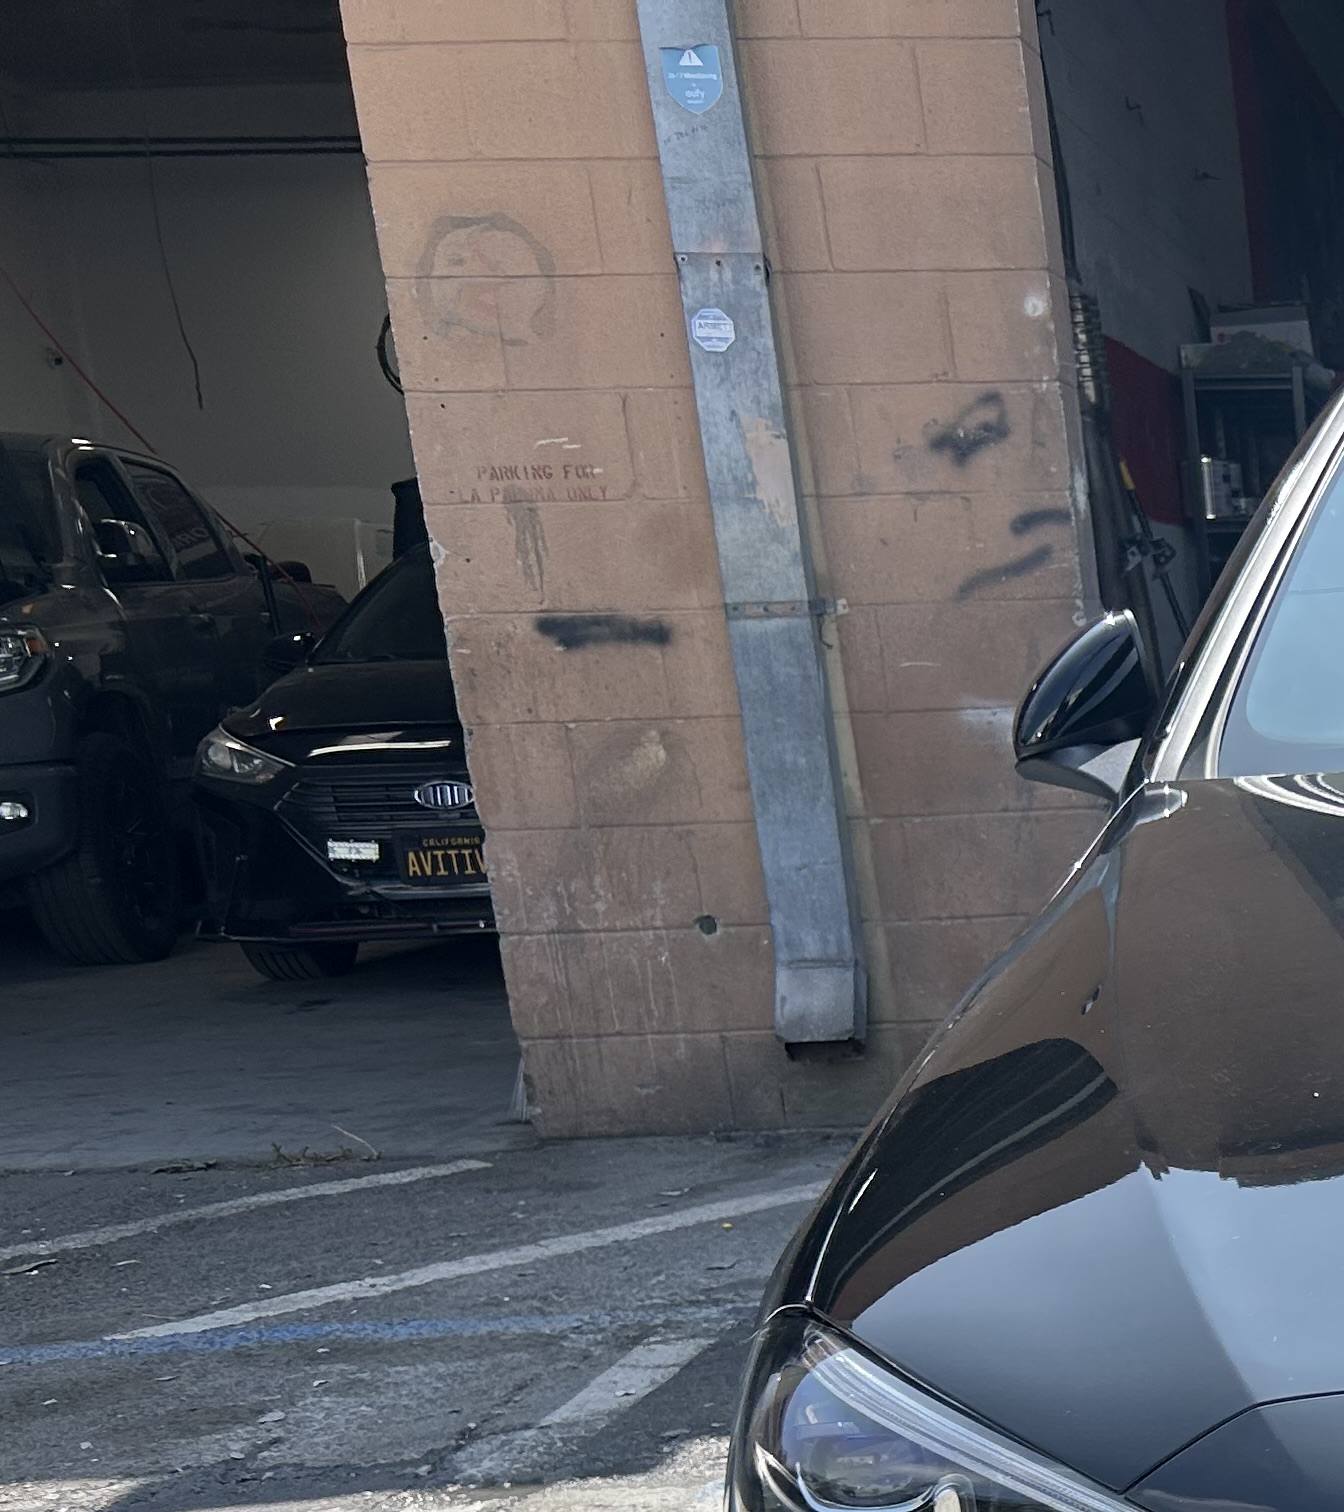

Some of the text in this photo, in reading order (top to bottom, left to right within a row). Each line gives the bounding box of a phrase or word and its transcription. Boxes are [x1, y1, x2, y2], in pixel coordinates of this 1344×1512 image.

[475, 463, 598, 481] PARKING FOR
[566, 483, 608, 501] ONLY
